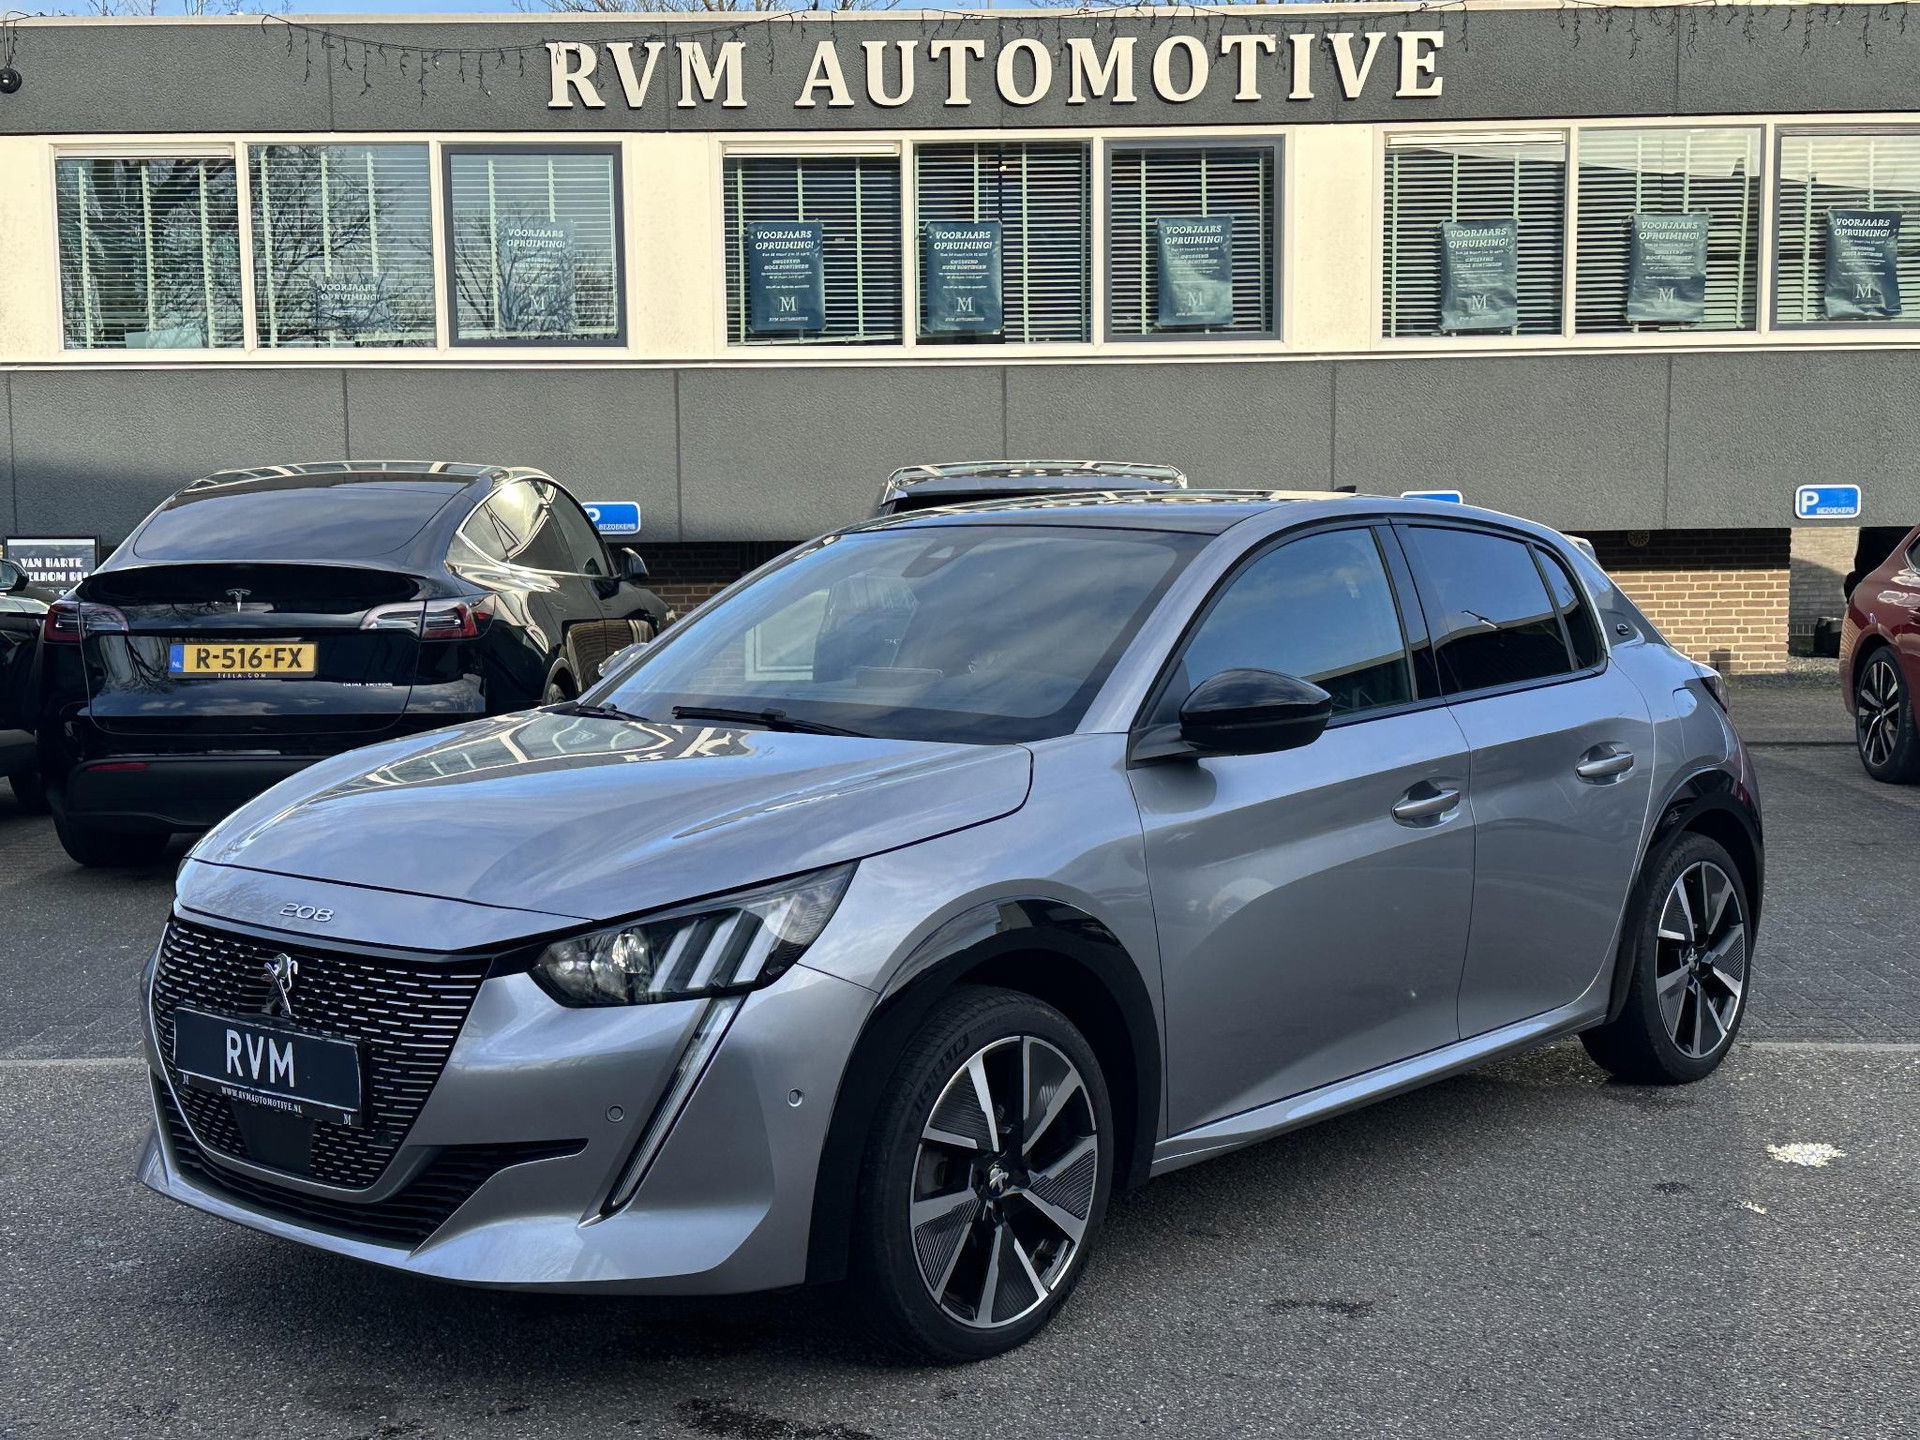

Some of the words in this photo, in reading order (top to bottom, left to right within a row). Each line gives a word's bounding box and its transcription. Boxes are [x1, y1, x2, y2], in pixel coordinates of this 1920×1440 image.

[545, 41, 748, 108] RVM
[794, 31, 1444, 108] AUTOMOTIVE
[1641, 221, 1698, 230] VOORJAARS
[1836, 218, 1891, 227] VOORJAARS
[508, 228, 564, 238] VOORJAARS
[756, 230, 812, 239] VOORJAARS
[1166, 225, 1222, 234] VOORJAARS
[1450, 228, 1507, 238] VOORJAARS
[1834, 228, 1891, 237] OPRUIMING!
[935, 231, 991, 239] VOORJAARS
[1164, 235, 1223, 245] OPRUIMING!
[1638, 231, 1700, 241] OPRUIMING!
[506, 239, 566, 249] OPRUIMING!
[755, 241, 814, 250] OPRUIMING!
[933, 241, 993, 250] OPRUIMING!
[1448, 238, 1509, 249] OPRUIMING!
[1801, 490, 1820, 513] P
[20, 557, 42, 568] VAN
[45, 557, 83, 568] HARTE
[27, 571, 67, 582] ELKOM
[195, 647, 303, 669] R-516-FX
[279, 902, 335, 922] 208
[226, 1028, 295, 1088] RVM
[221, 1085, 303, 1114] WWW.RVMAUTOMOTIVE.NL
